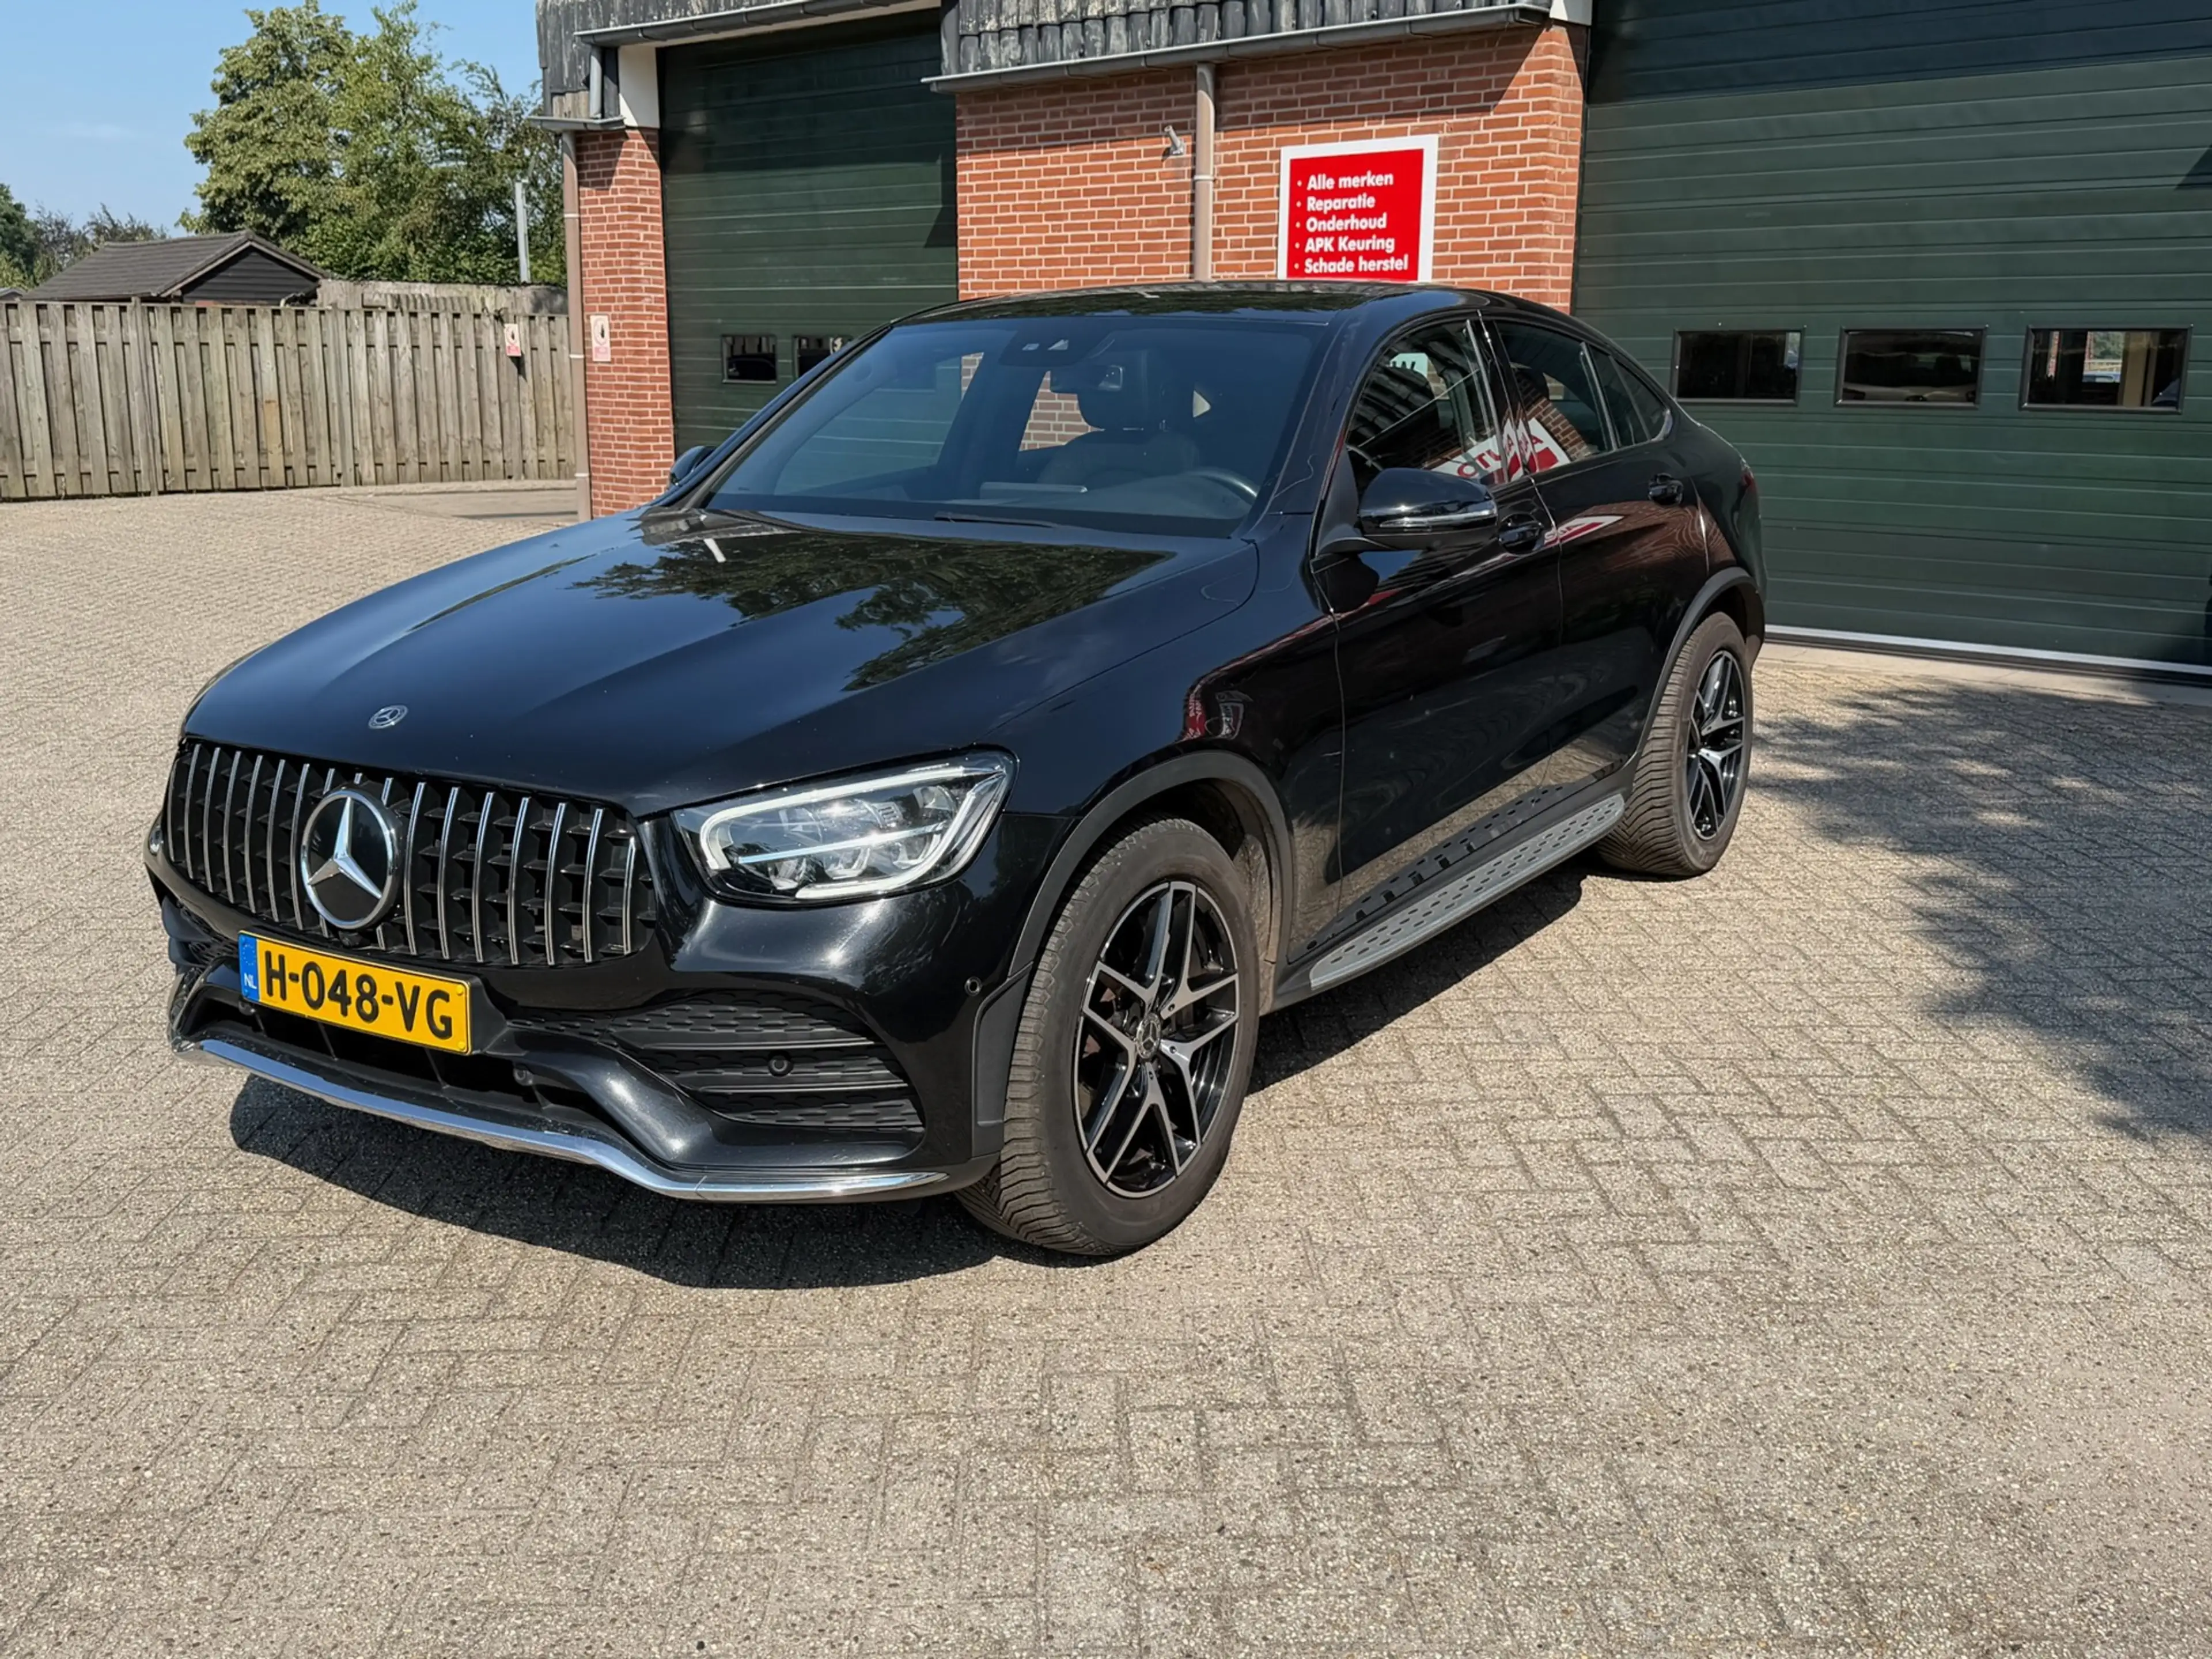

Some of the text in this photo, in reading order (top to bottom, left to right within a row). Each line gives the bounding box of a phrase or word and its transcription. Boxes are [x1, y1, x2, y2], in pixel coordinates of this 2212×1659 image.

[1306, 170, 1393, 190] Alle merken
[1306, 192, 1376, 214] Reparatie
[1305, 212, 1387, 232] Onderhoud
[1305, 233, 1395, 253] APK Keuring
[1304, 253, 1408, 274] Schade herstel
[244, 974, 257, 990] NL
[264, 950, 453, 1040] H-048-VG
